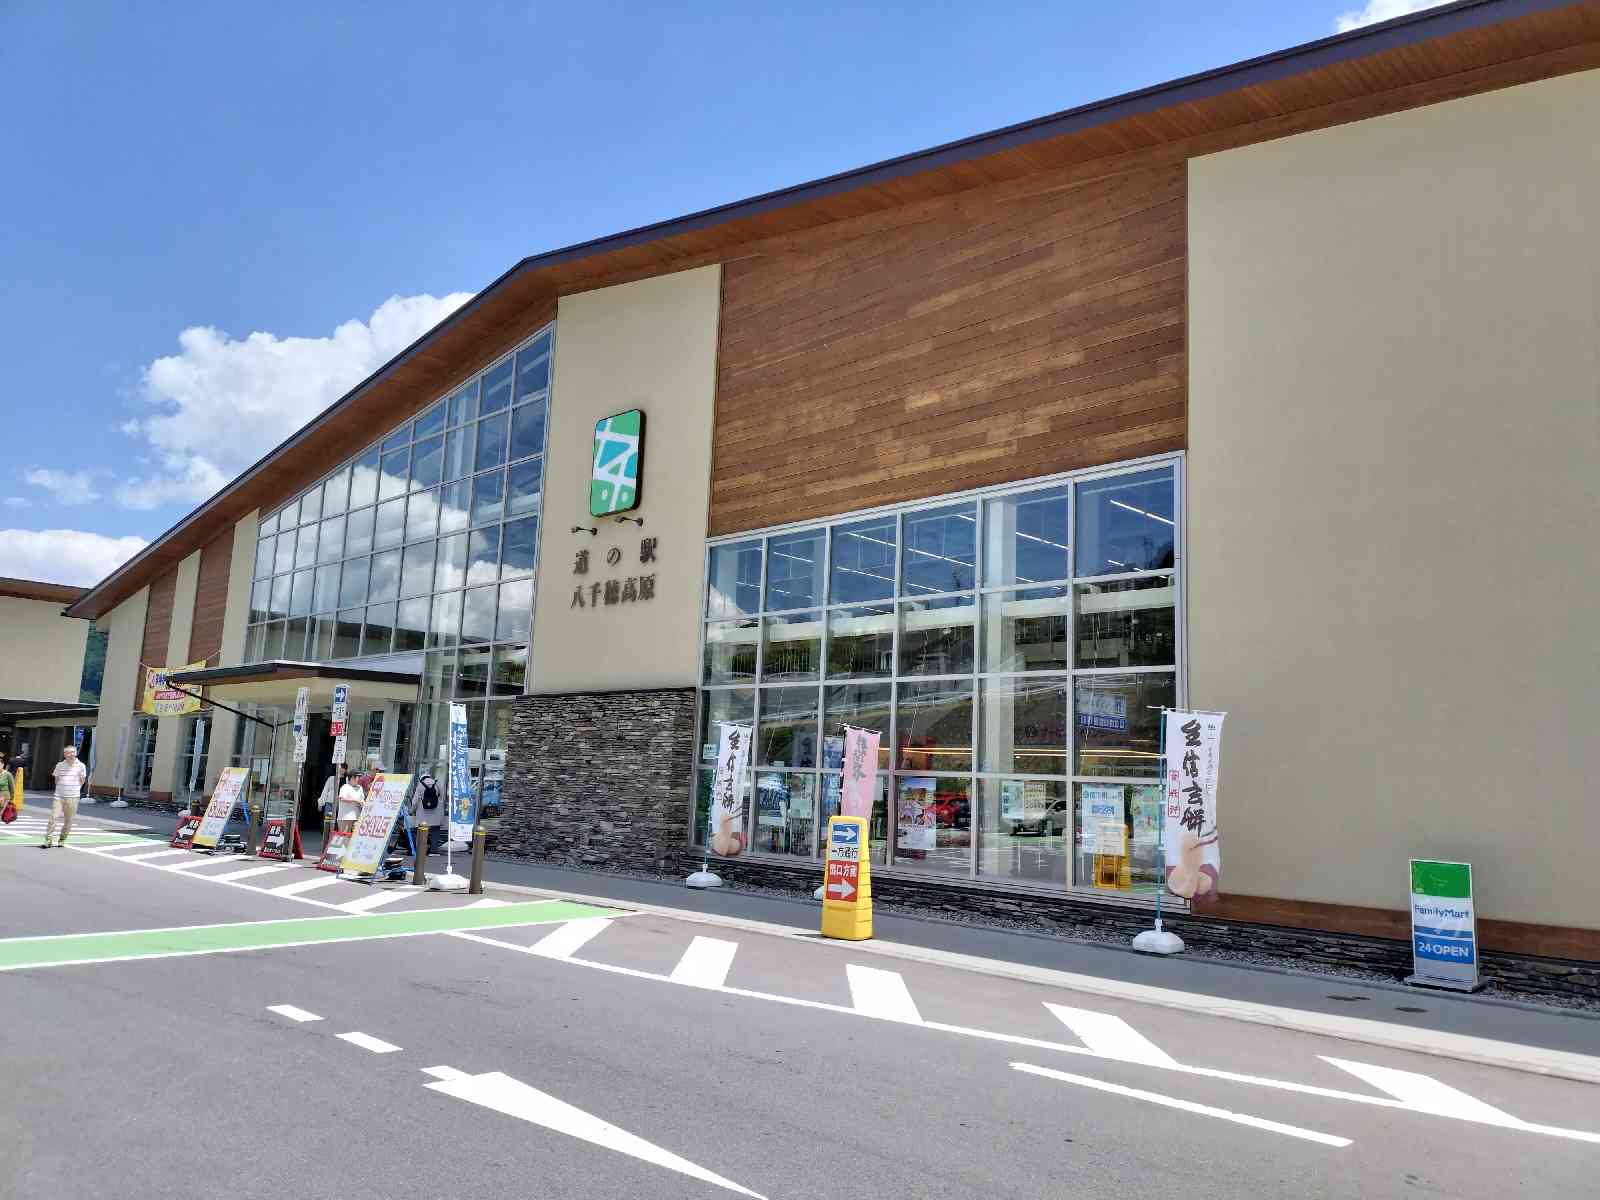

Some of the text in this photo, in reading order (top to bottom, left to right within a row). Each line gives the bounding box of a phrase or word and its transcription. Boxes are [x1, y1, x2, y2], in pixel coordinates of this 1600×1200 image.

[573, 538, 657, 574] 道の駅
[571, 573, 655, 608] 八千穂高原
[1415, 904, 1469, 920] FamilyMart
